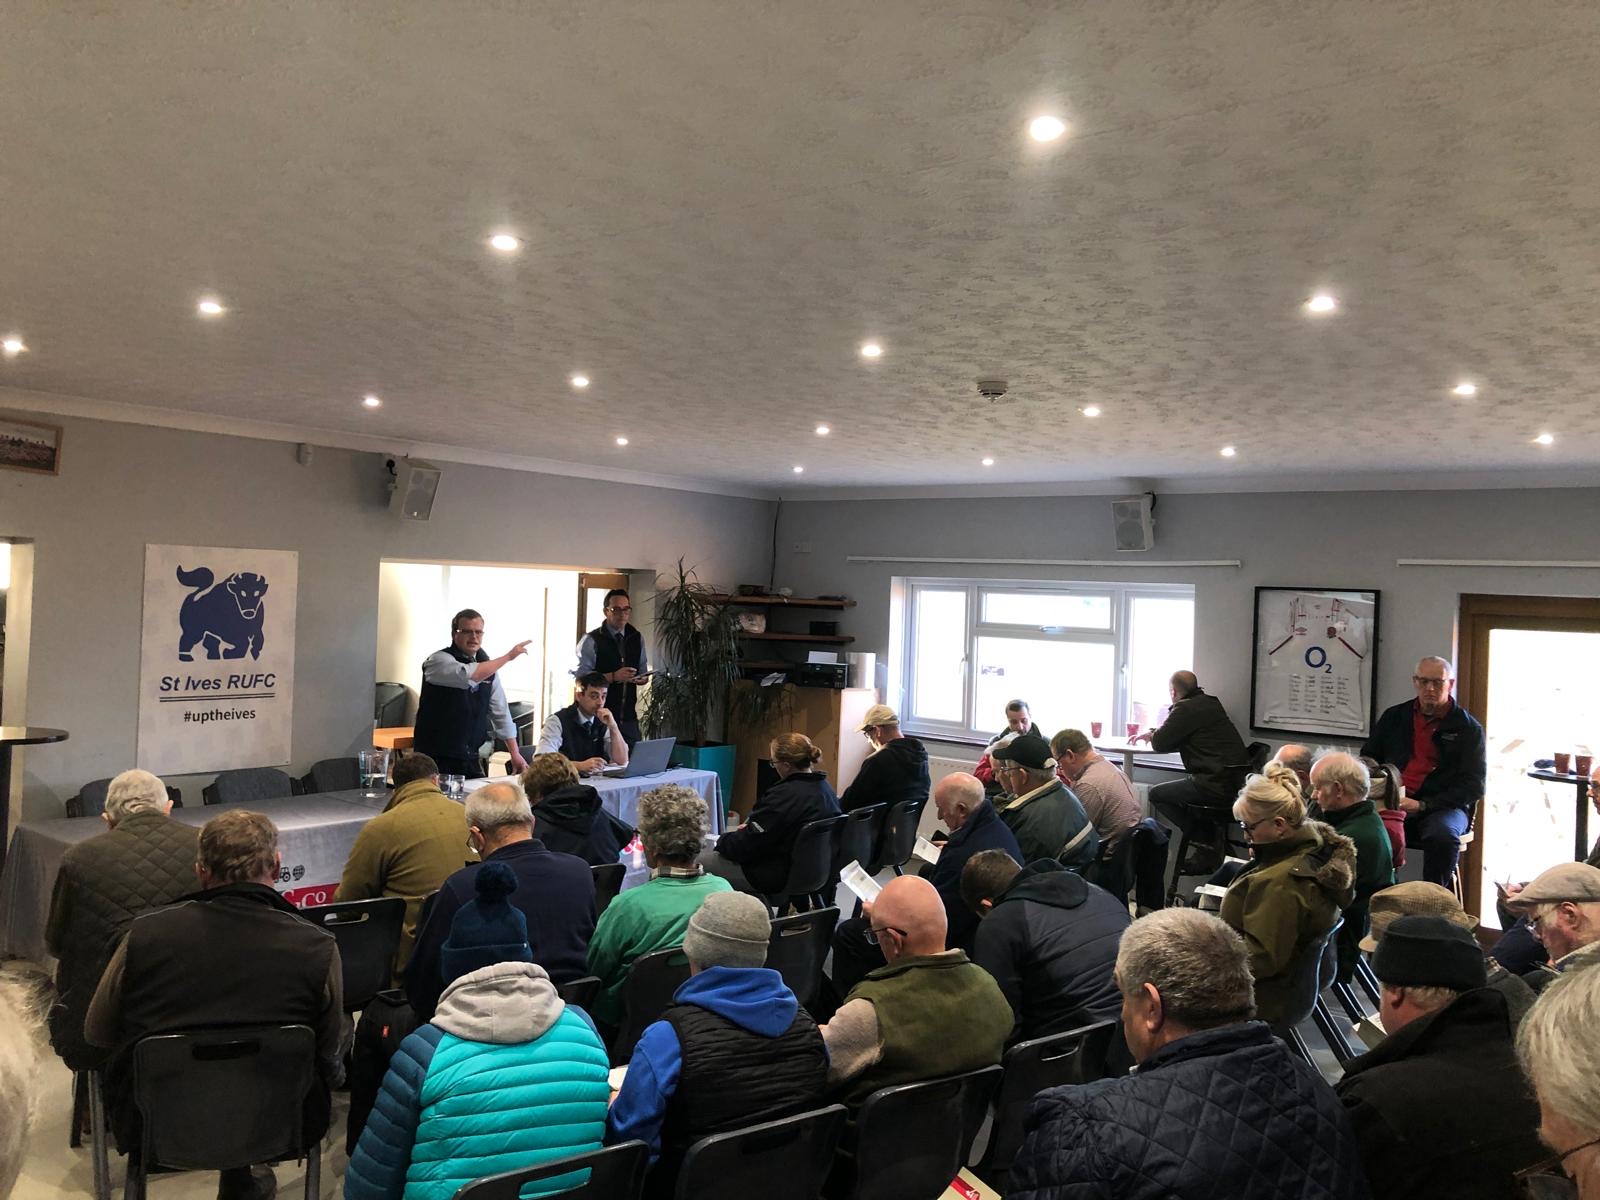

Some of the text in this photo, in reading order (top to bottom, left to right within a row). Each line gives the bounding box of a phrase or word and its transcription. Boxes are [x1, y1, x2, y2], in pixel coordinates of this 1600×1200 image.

[160, 673, 276, 691] St Ives RUFC
[184, 708, 256, 724] #uptheives
